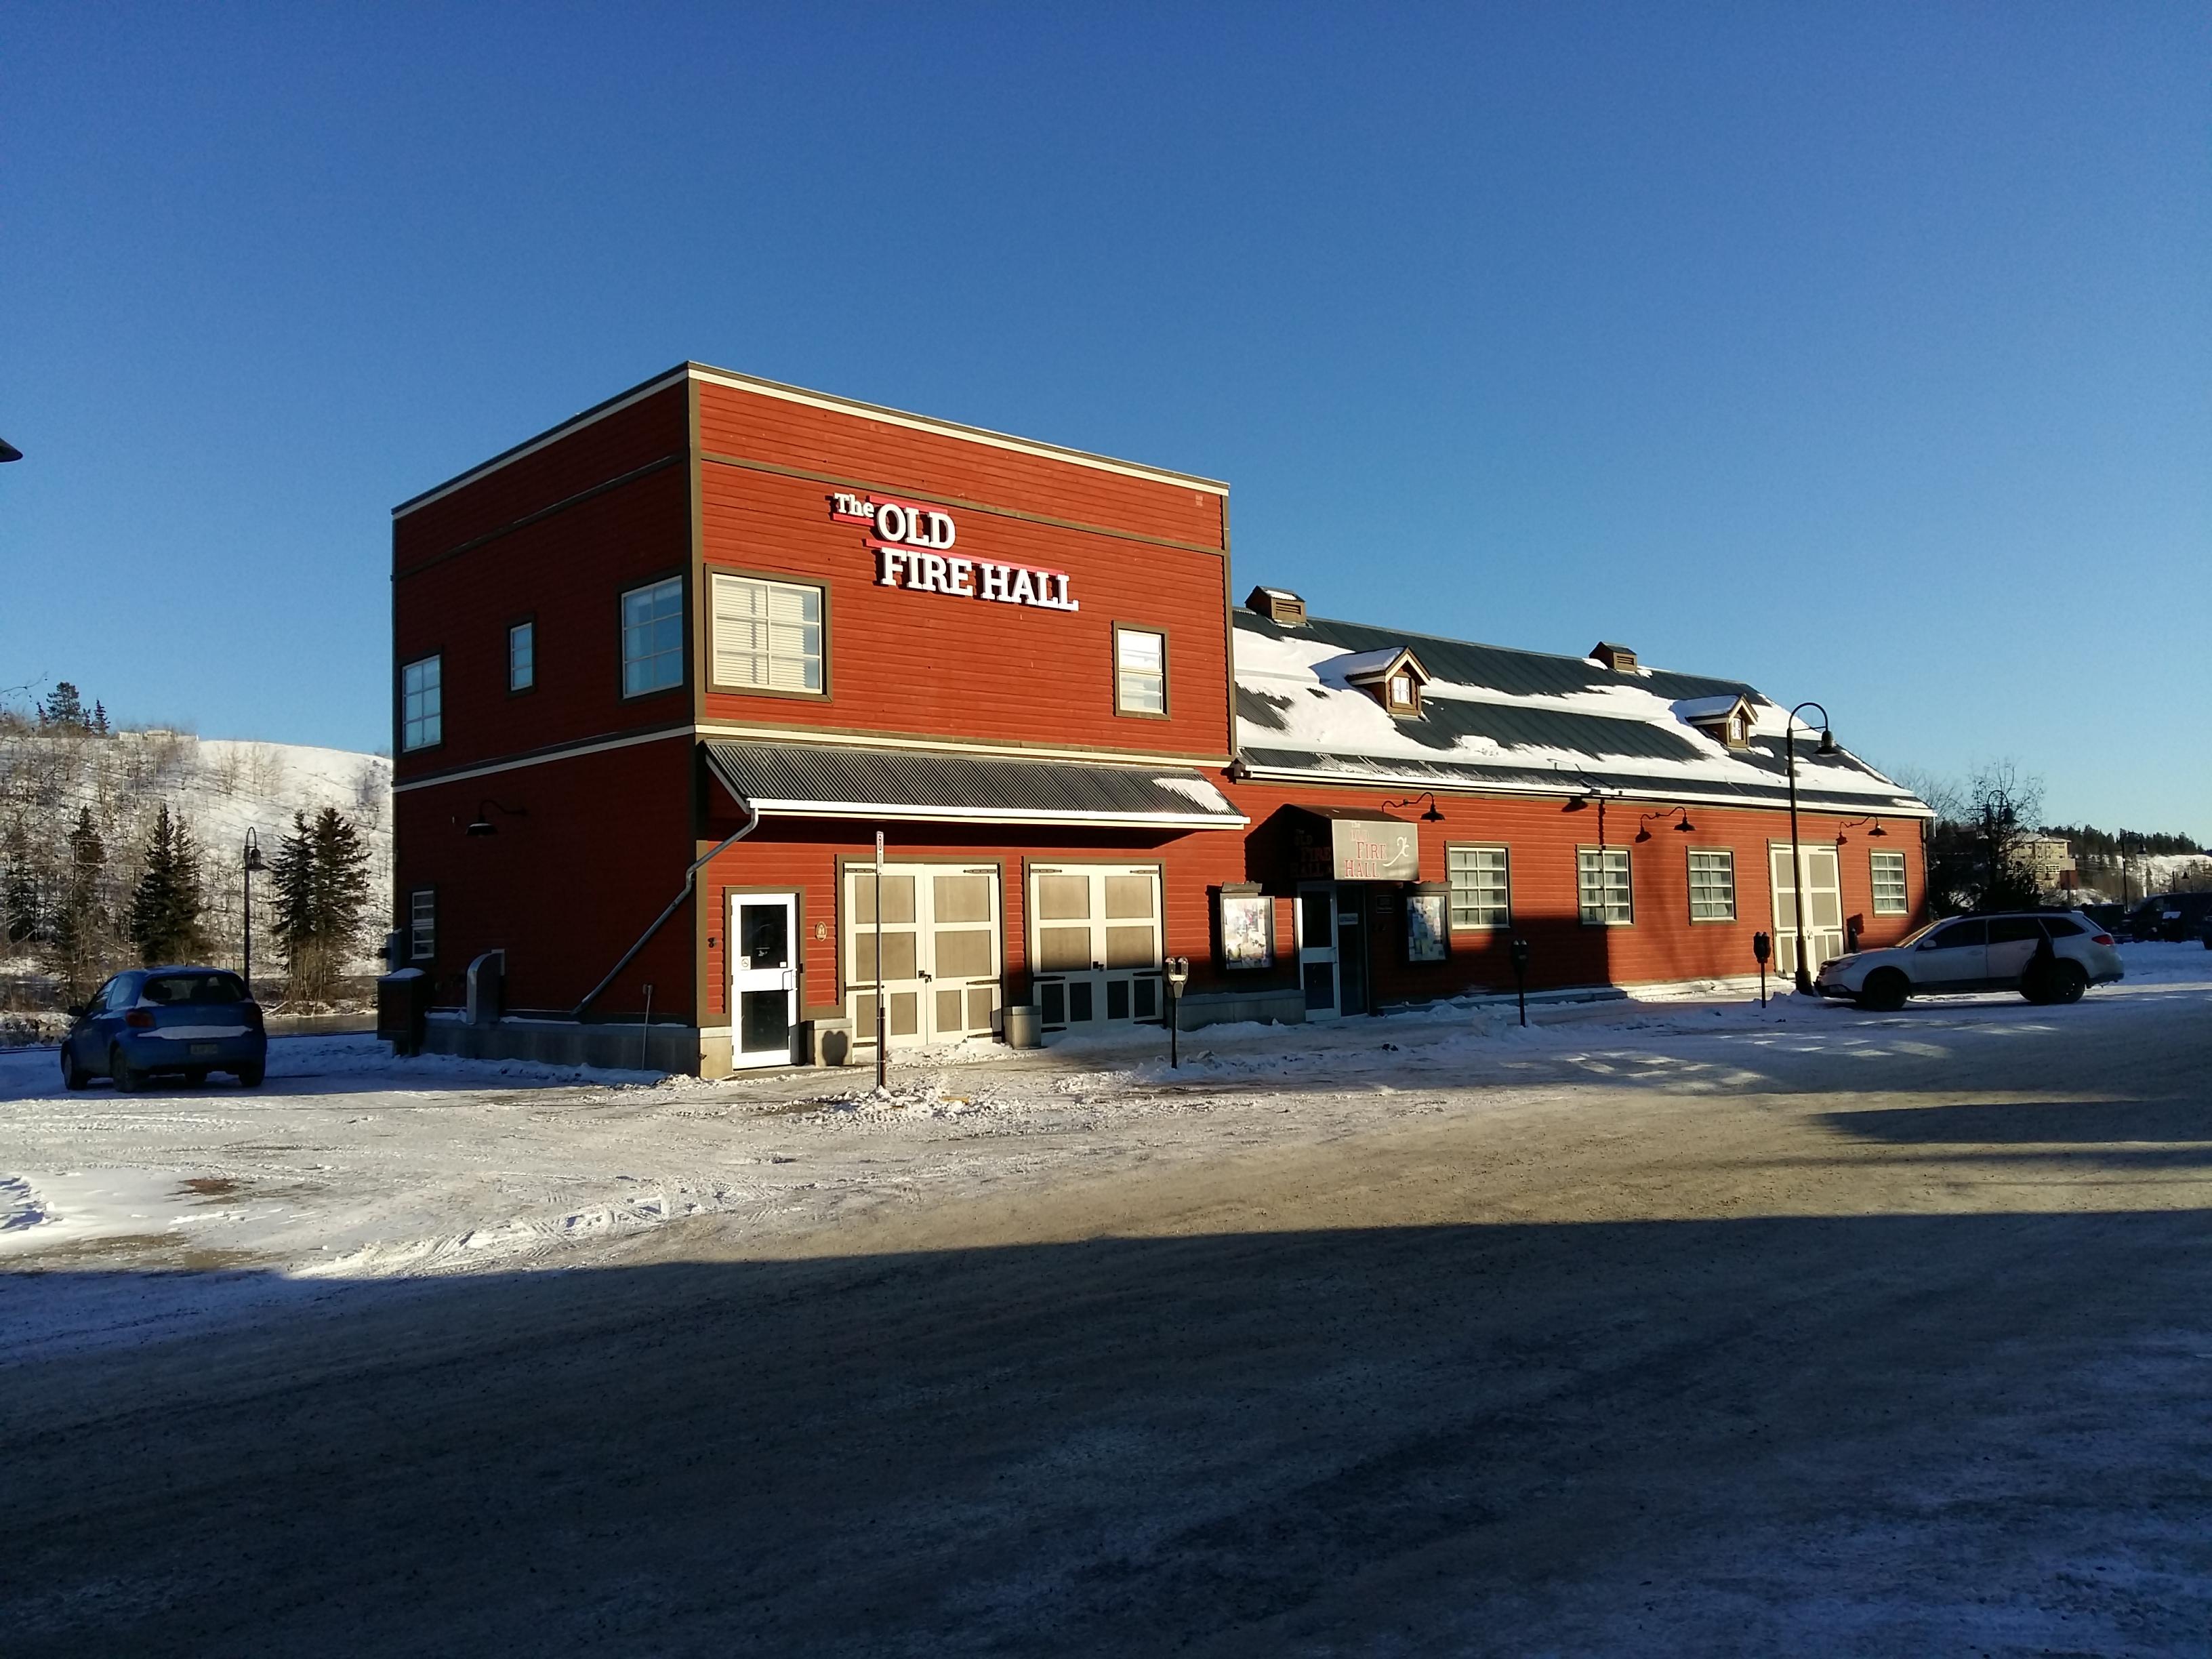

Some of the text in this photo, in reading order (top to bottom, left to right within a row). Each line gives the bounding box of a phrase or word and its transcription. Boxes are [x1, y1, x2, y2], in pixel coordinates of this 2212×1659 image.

[834, 493, 956, 550] The OLD
[880, 547, 1080, 611] FIRE HALL
[1345, 859, 1380, 878] HALL
[1356, 840, 1388, 860] FIRE
